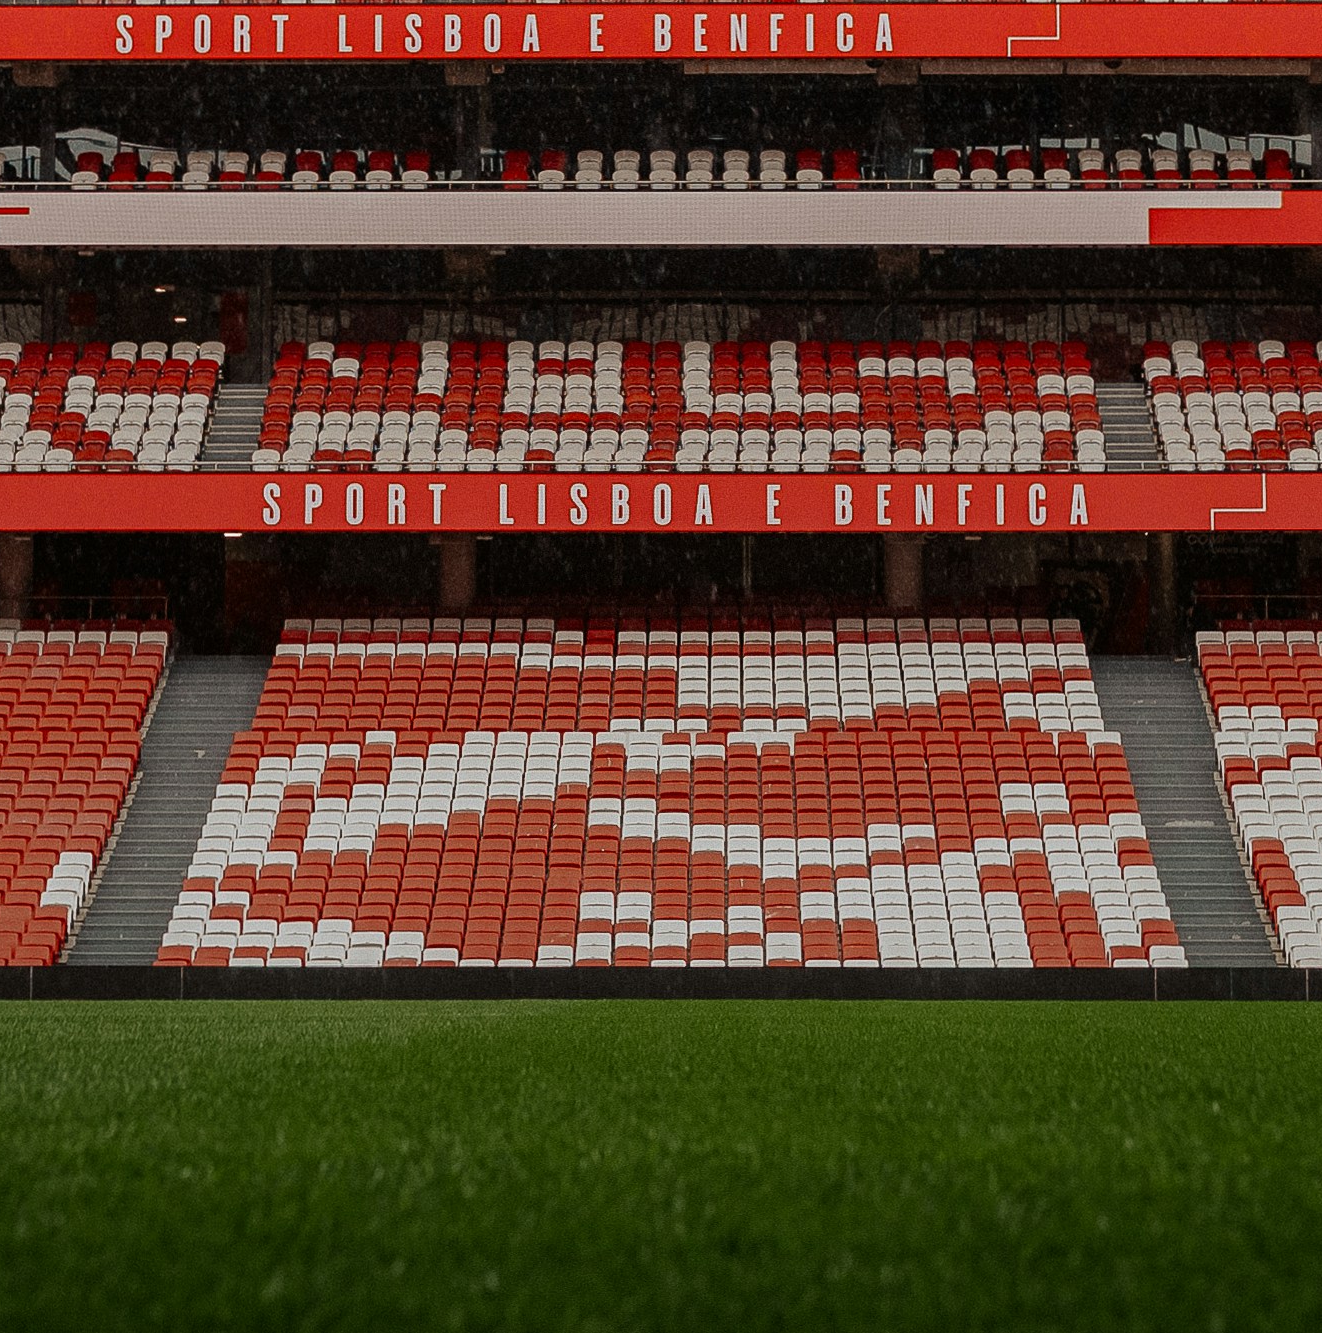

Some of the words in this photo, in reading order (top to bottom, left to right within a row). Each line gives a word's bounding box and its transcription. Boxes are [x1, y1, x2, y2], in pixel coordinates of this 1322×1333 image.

[115, 14, 289, 54] SPORT
[338, 13, 540, 53] LISBOA
[590, 13, 604, 52] E
[654, 12, 893, 52] BENFICA
[262, 482, 447, 525] SPORT
[499, 483, 713, 526] LISBOA
[766, 484, 781, 525] E
[834, 483, 1089, 526] BENFICA
